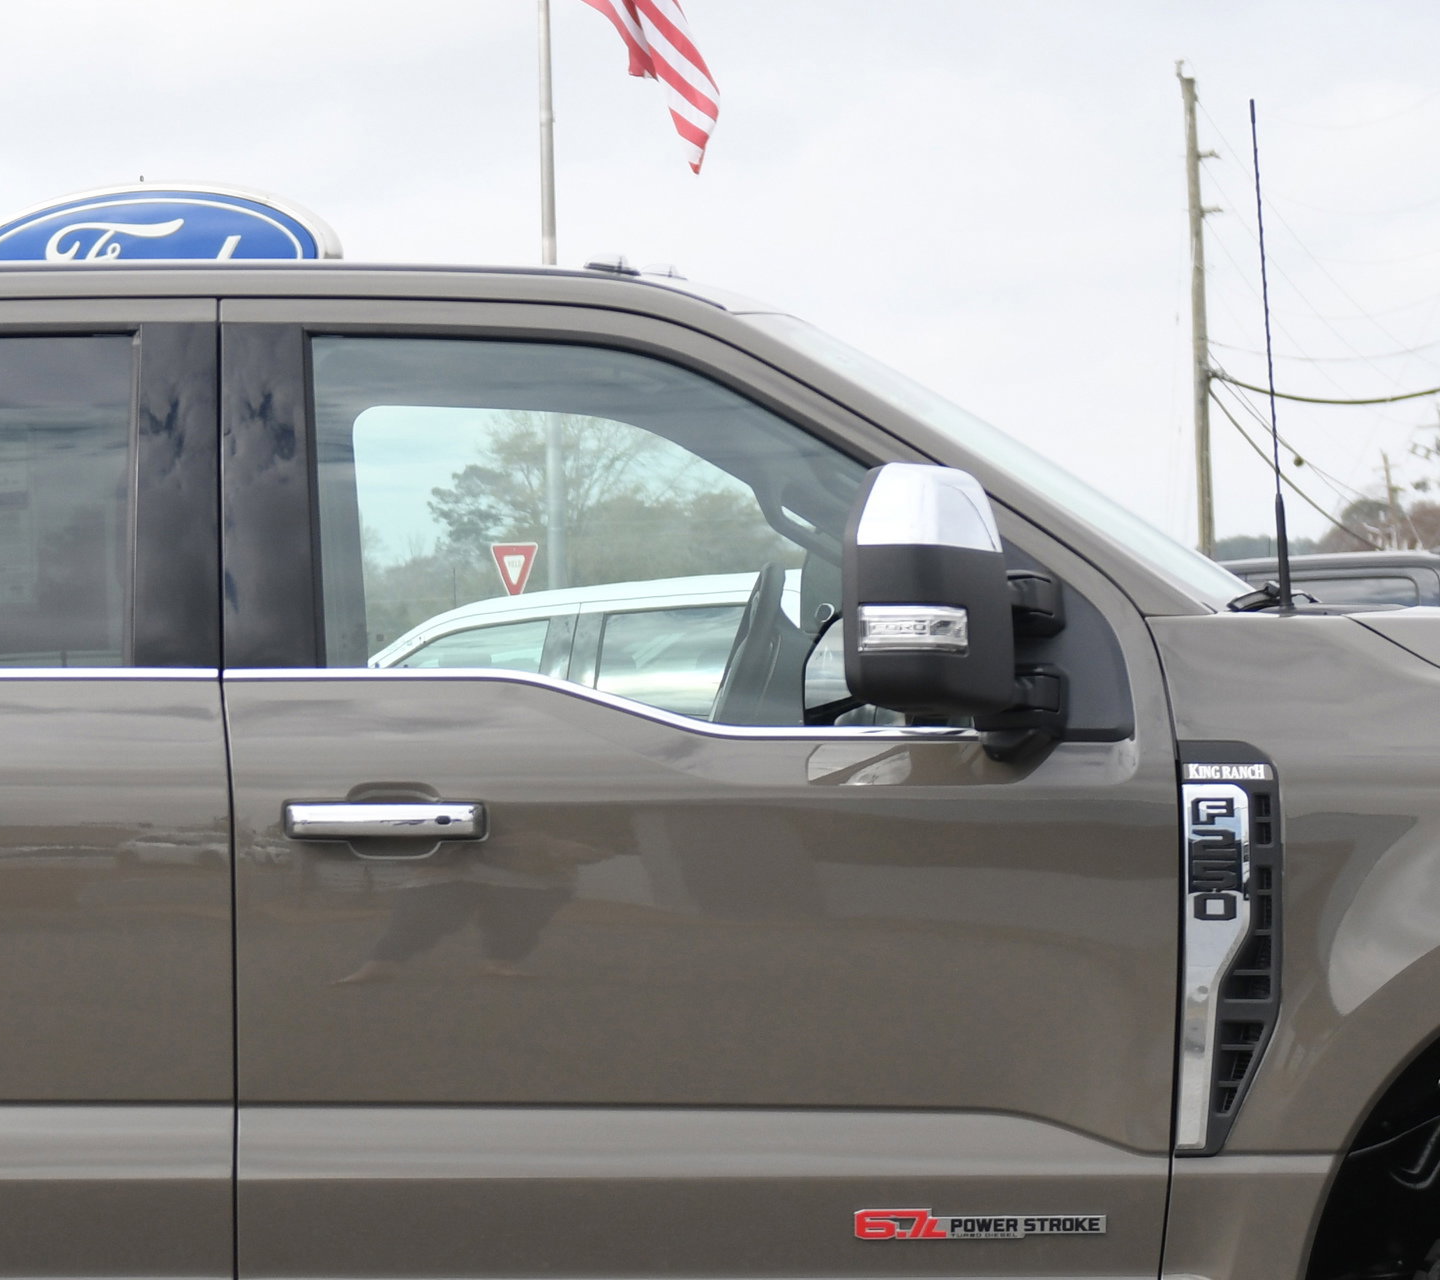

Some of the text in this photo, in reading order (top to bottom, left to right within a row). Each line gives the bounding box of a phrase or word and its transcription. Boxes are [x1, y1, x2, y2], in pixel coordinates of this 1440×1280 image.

[1188, 763, 1265, 780] KING RANCH
[854, 1209, 1100, 1239] 6.7L POWER STROKE
